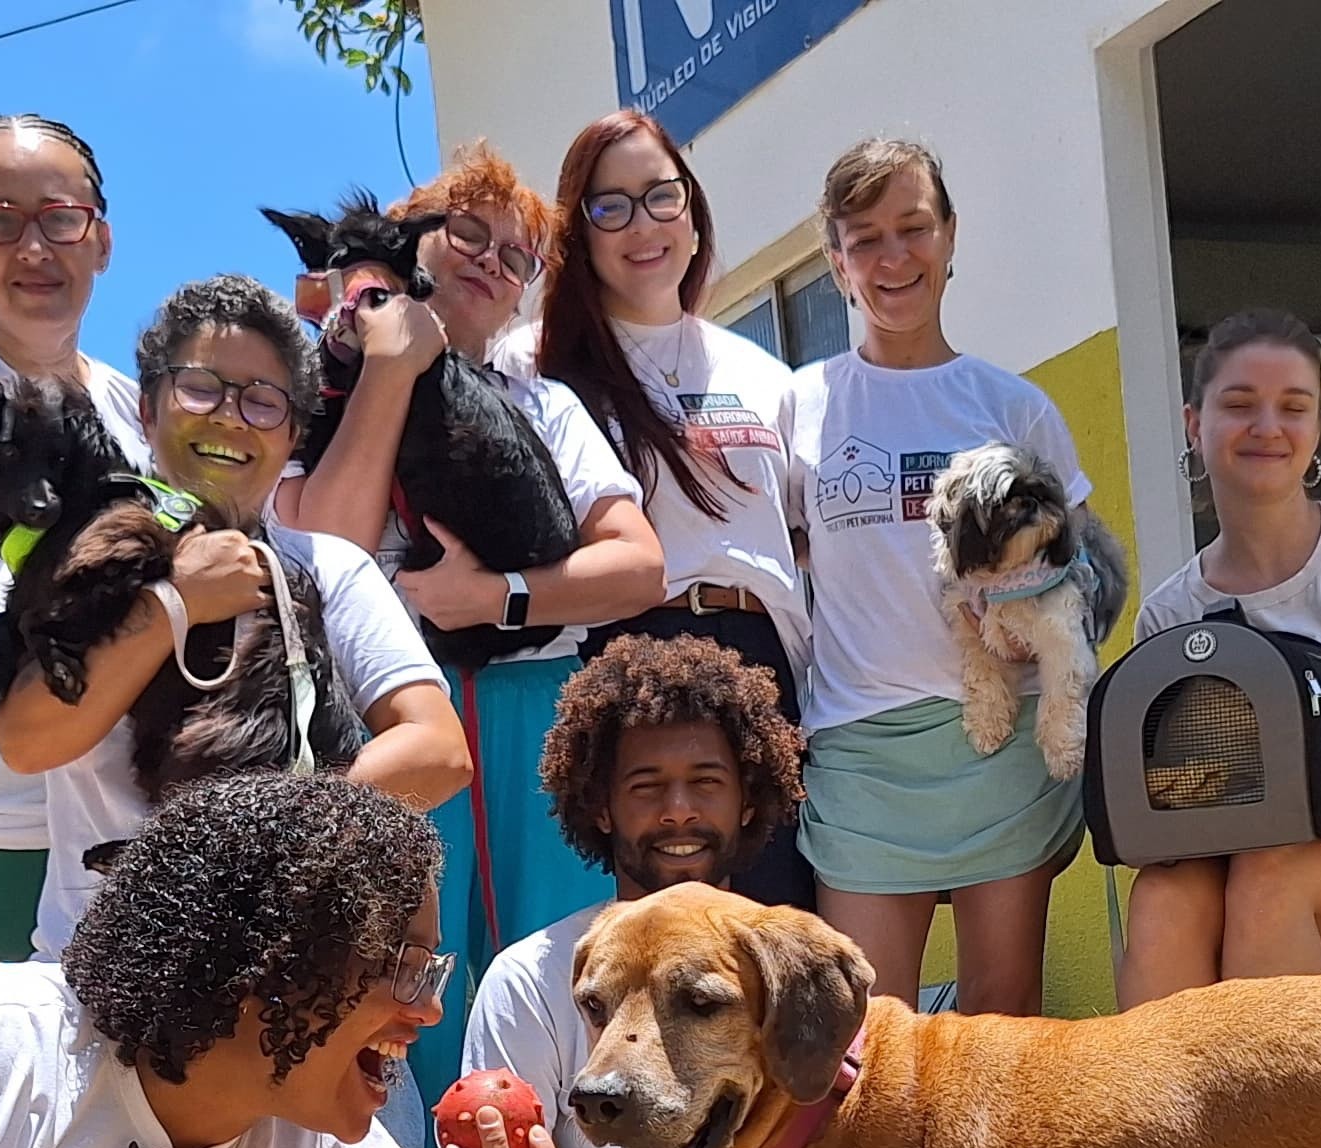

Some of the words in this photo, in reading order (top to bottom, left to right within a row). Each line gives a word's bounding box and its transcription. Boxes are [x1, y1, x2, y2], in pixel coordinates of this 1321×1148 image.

[632, 57, 696, 115] NÚCLEO
[700, 33, 724, 65] DE
[904, 475, 927, 492] PET
[905, 499, 921, 517] DE
[846, 516, 859, 528] PET
[860, 513, 895, 527] NORONHA
